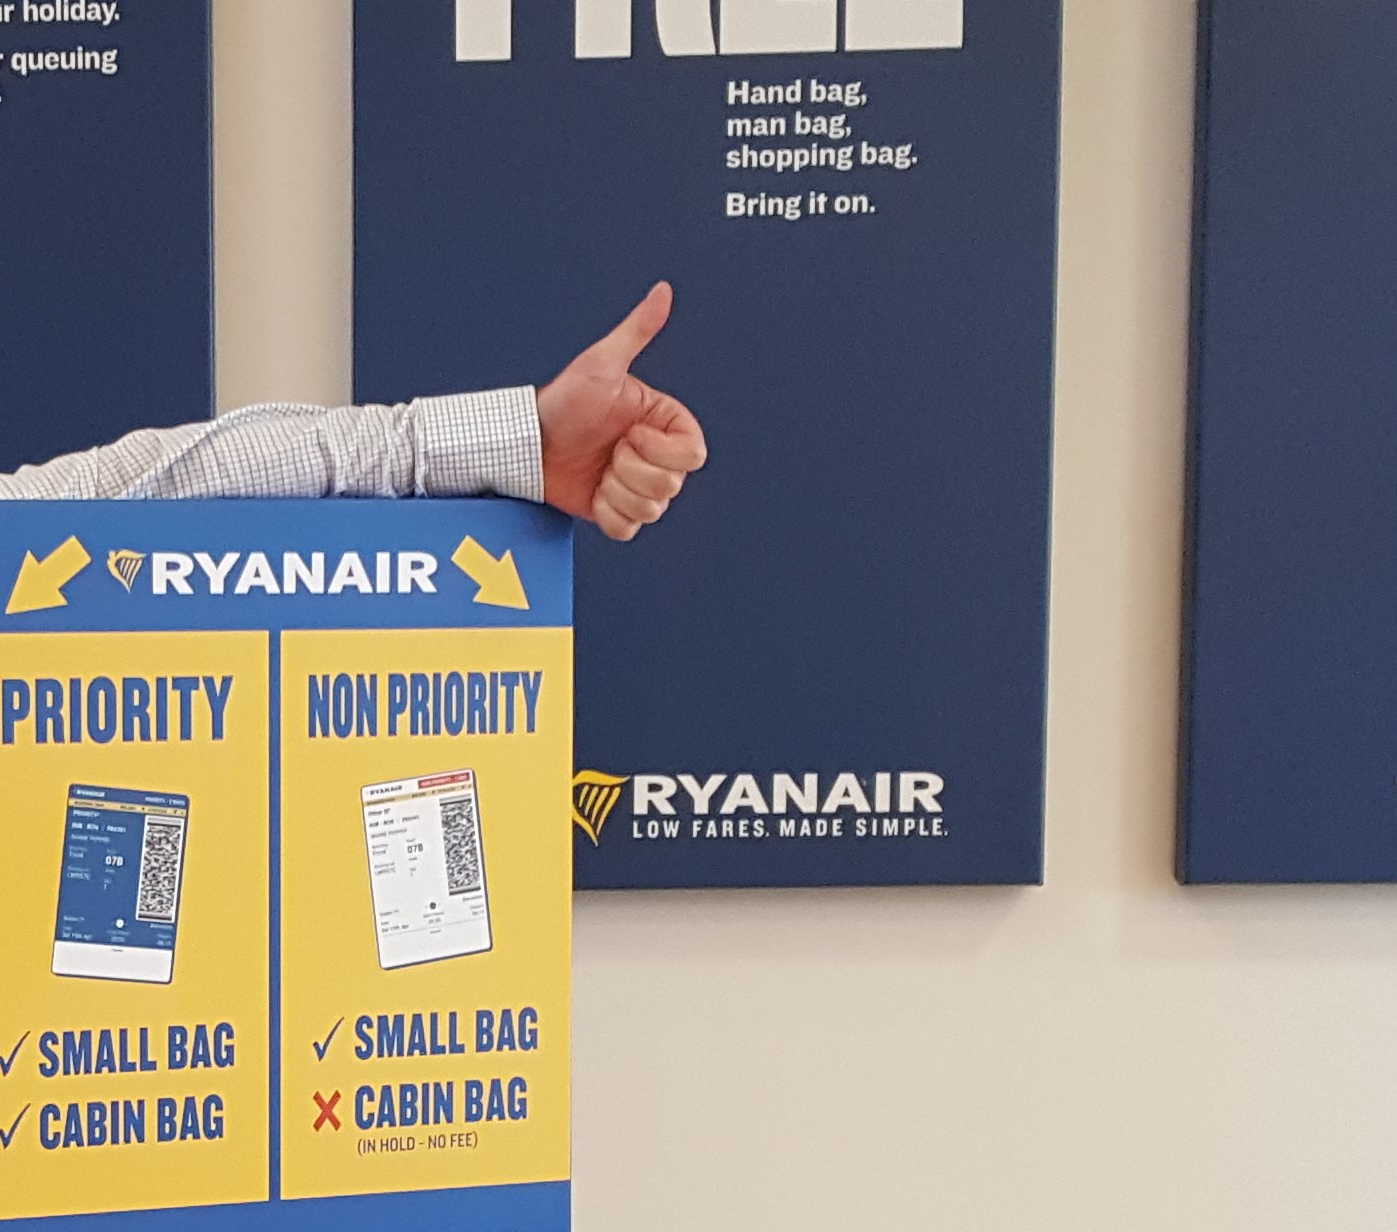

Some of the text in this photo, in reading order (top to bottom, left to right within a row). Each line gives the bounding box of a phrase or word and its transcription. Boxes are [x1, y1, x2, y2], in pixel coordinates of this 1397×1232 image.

[23, 0, 120, 25] holiday.
[11, 46, 118, 76] queuing
[727, 79, 868, 107] Hand bag,
[727, 112, 852, 139] man bag,
[726, 142, 918, 172] shopping bag.
[726, 193, 876, 220] Bring it on.
[151, 551, 439, 596] RYANAIR
[2, 675, 234, 745] PRIORITY
[308, 670, 543, 740] NON PRIORITY
[633, 772, 944, 815] RYANAIR
[633, 817, 949, 839] LOW FARES. MADE SIMPLE.
[38, 1021, 236, 1079] SMALL BAG
[354, 1006, 539, 1061] SMALL BAG
[354, 1075, 528, 1131] CABIN BAG
[39, 1093, 224, 1150] CABIN BAG
[356, 1138, 376, 1156] (IN
[379, 1135, 415, 1153] HOLD
[427, 1133, 446, 1151] NO
[448, 1131, 478, 1151] FEE)
